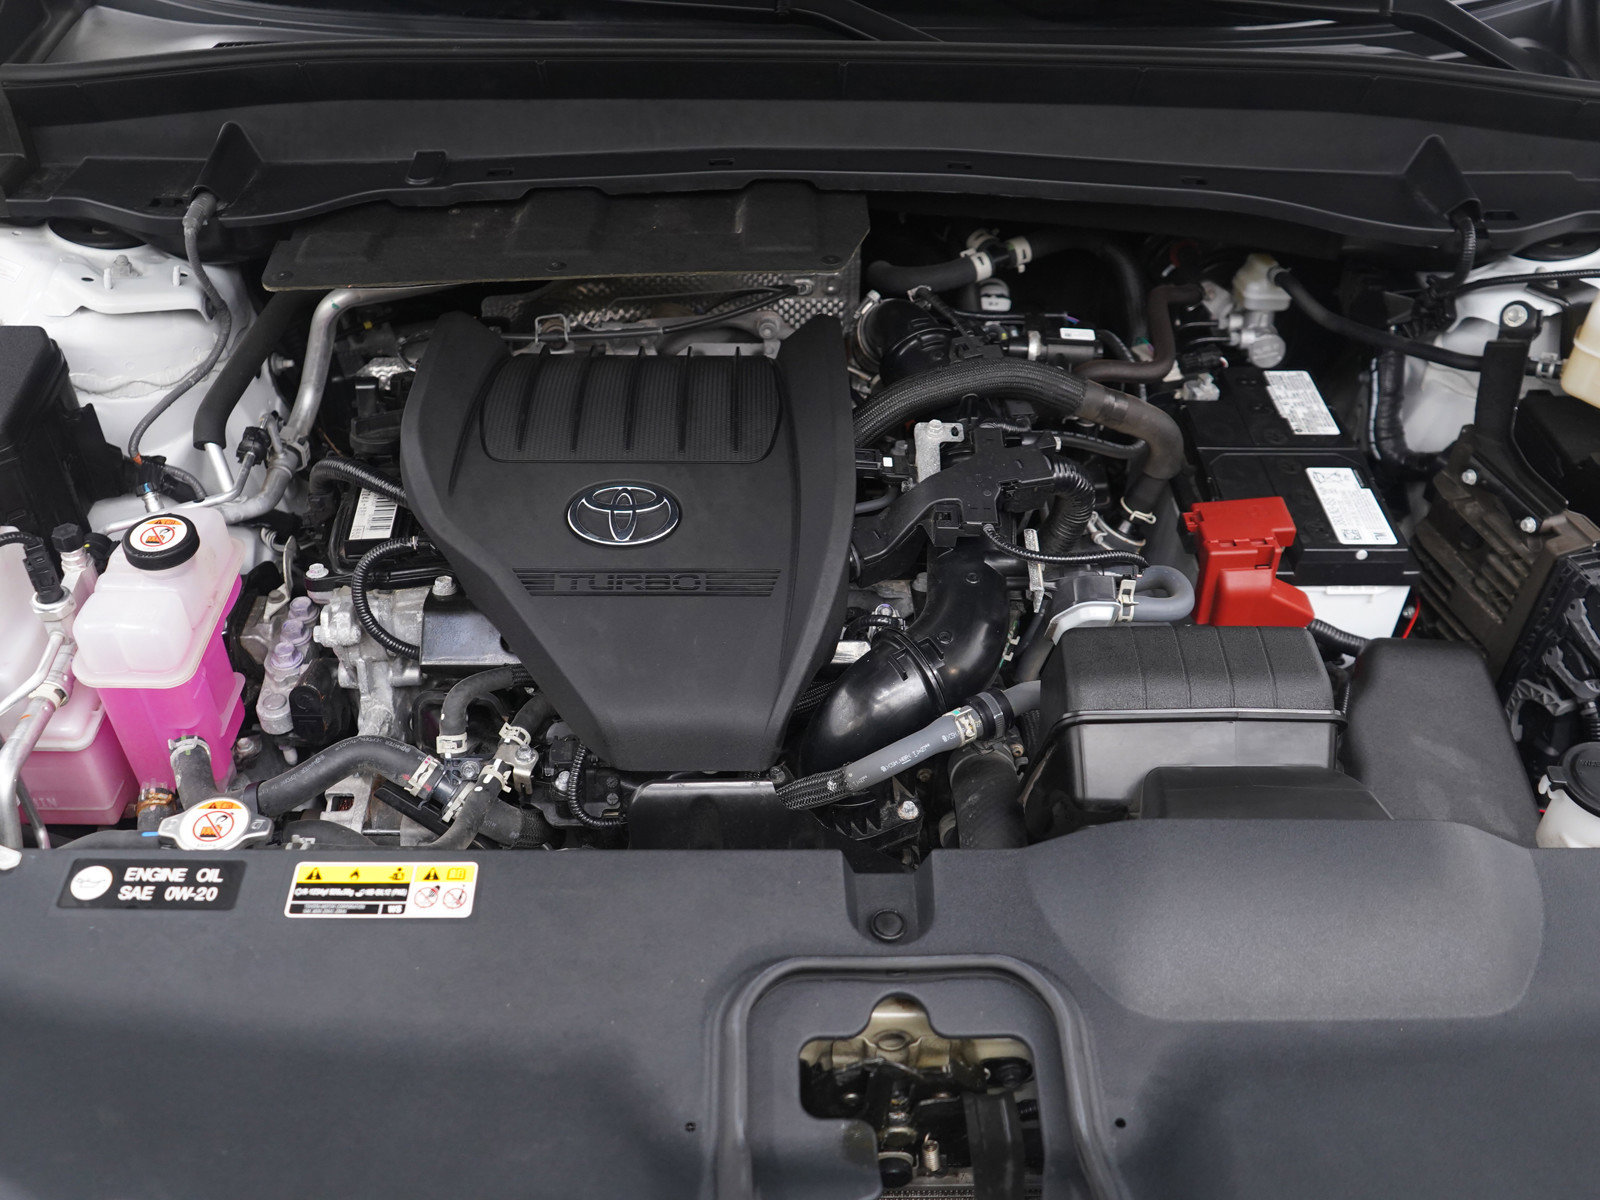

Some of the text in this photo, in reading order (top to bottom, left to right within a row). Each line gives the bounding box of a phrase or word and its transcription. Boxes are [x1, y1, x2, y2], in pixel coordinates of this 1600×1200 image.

[559, 573, 702, 592] TURBO
[123, 867, 224, 883] ENGINE OIL
[117, 885, 219, 902] SAE 0W-20
